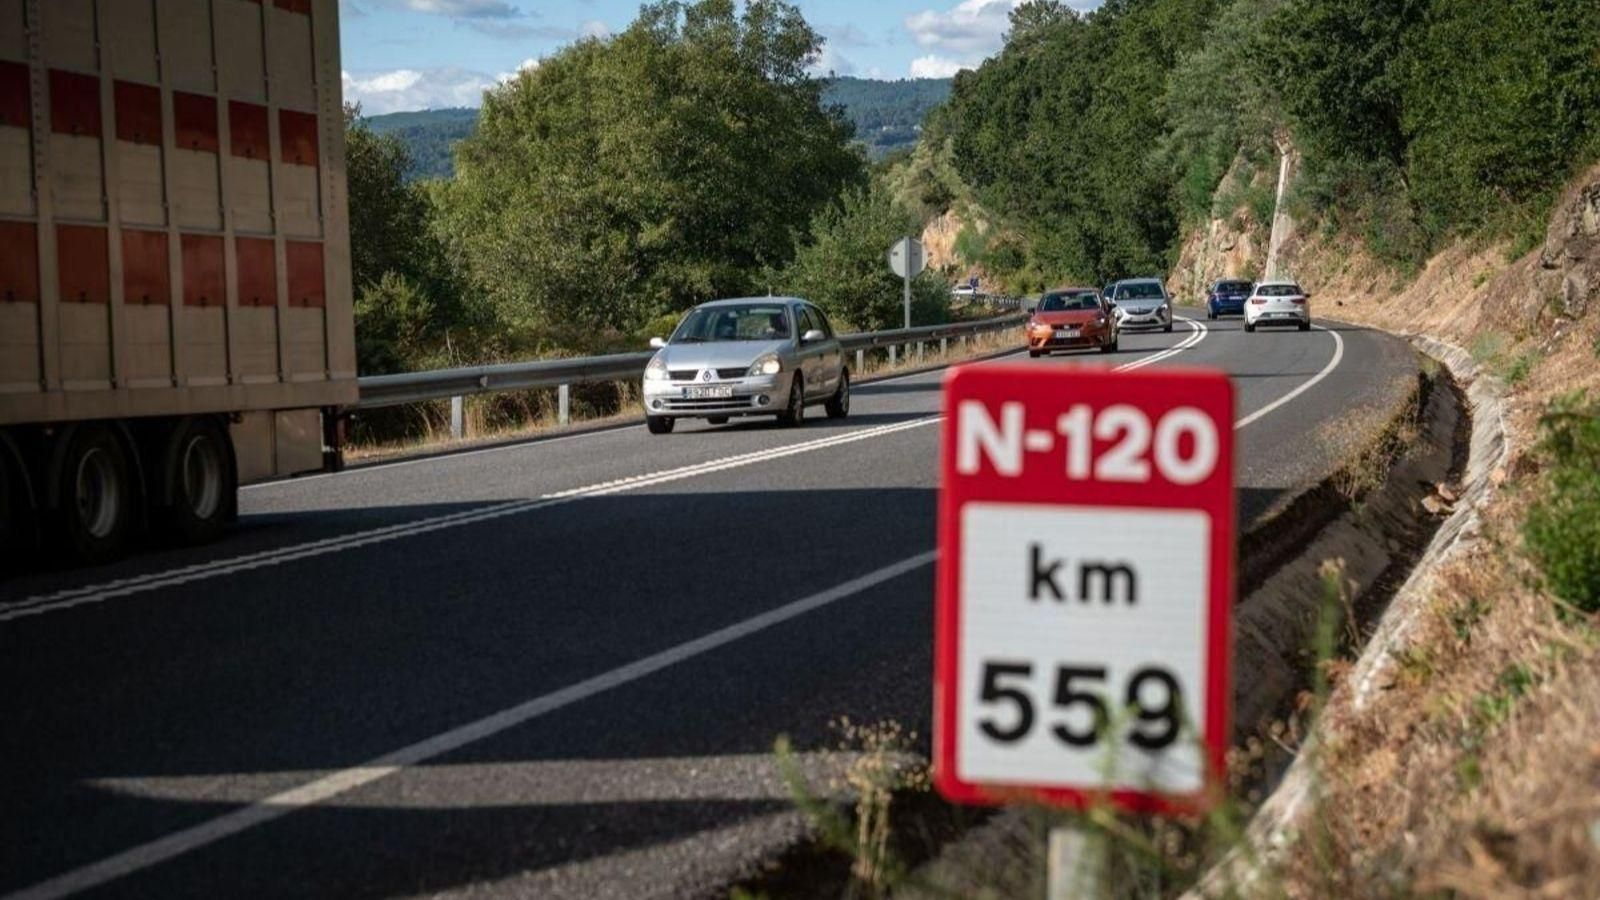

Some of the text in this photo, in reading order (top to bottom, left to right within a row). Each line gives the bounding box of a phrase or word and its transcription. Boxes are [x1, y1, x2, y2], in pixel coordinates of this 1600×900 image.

[957, 400, 1220, 485] N-120
[1028, 543, 1137, 604] km
[978, 661, 1182, 750] 559
